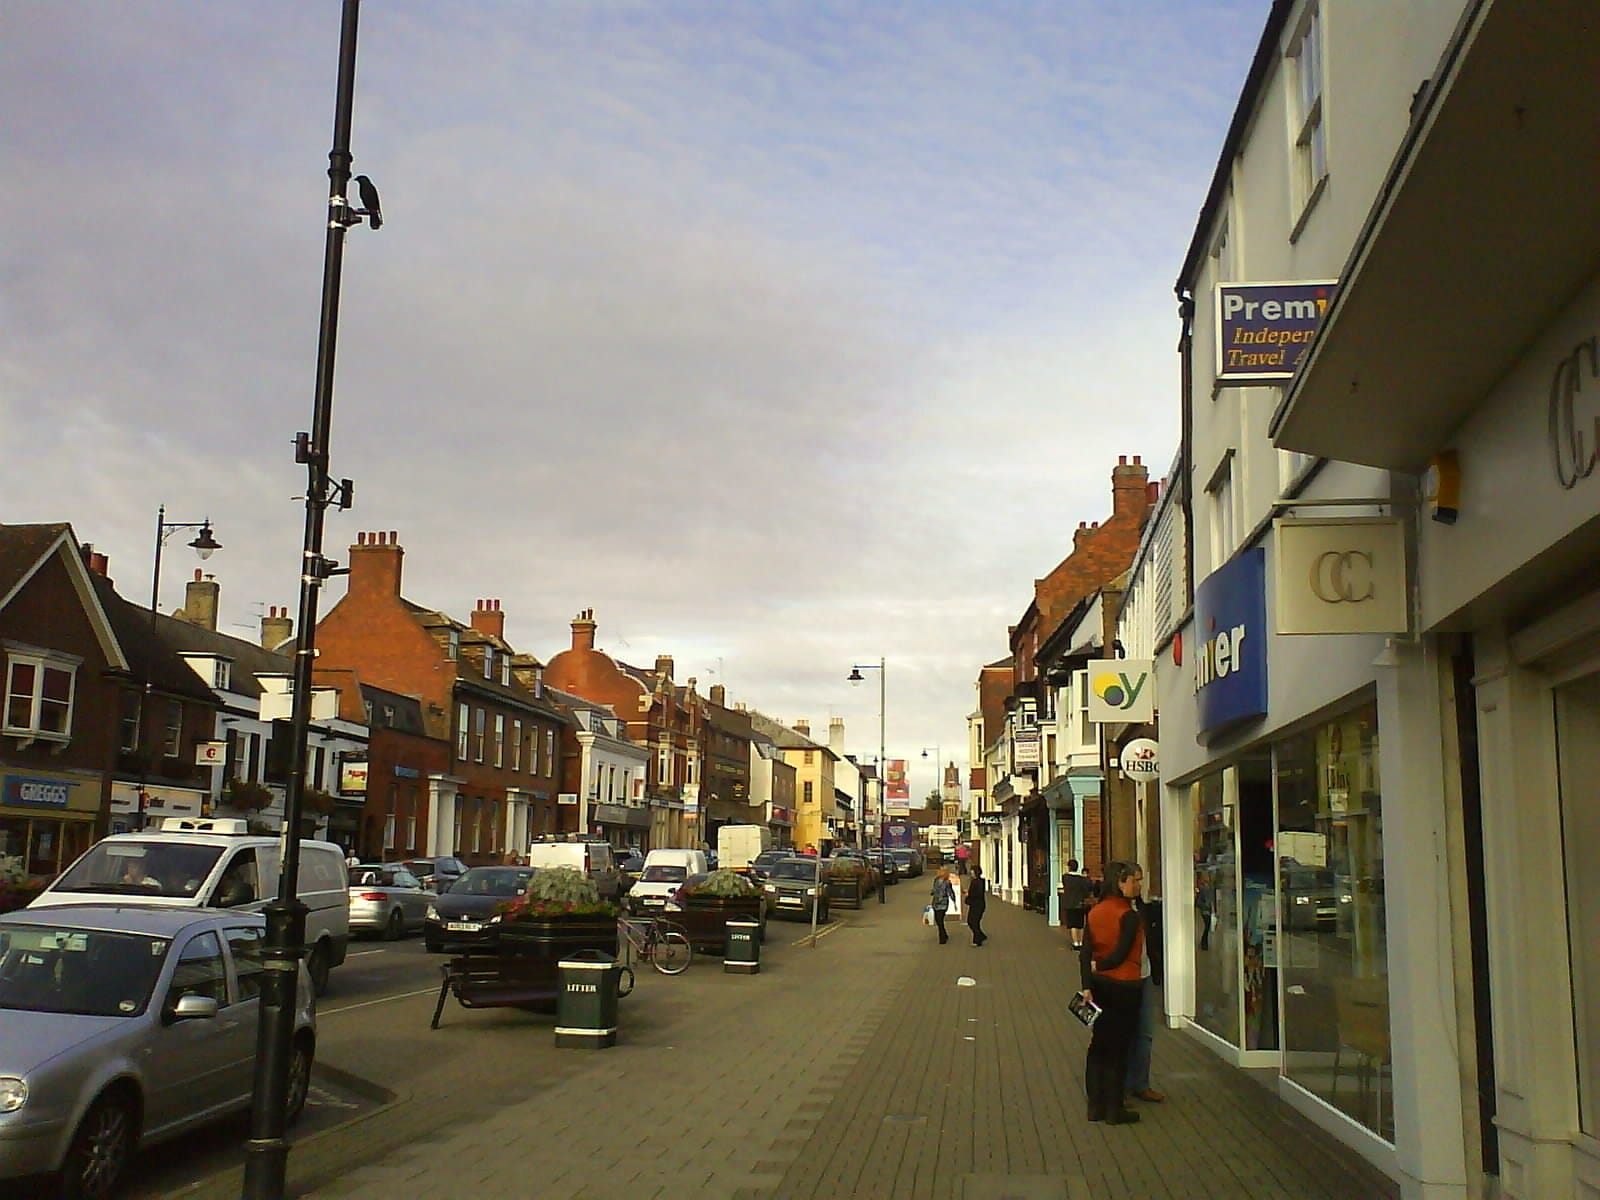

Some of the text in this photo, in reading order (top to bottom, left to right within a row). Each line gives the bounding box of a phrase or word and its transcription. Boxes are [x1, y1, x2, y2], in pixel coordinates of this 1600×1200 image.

[1227, 349, 1286, 367] Travel
[1308, 550, 1376, 604] CC
[20, 782, 66, 803] GREGGS
[567, 983, 597, 993] LITTER
